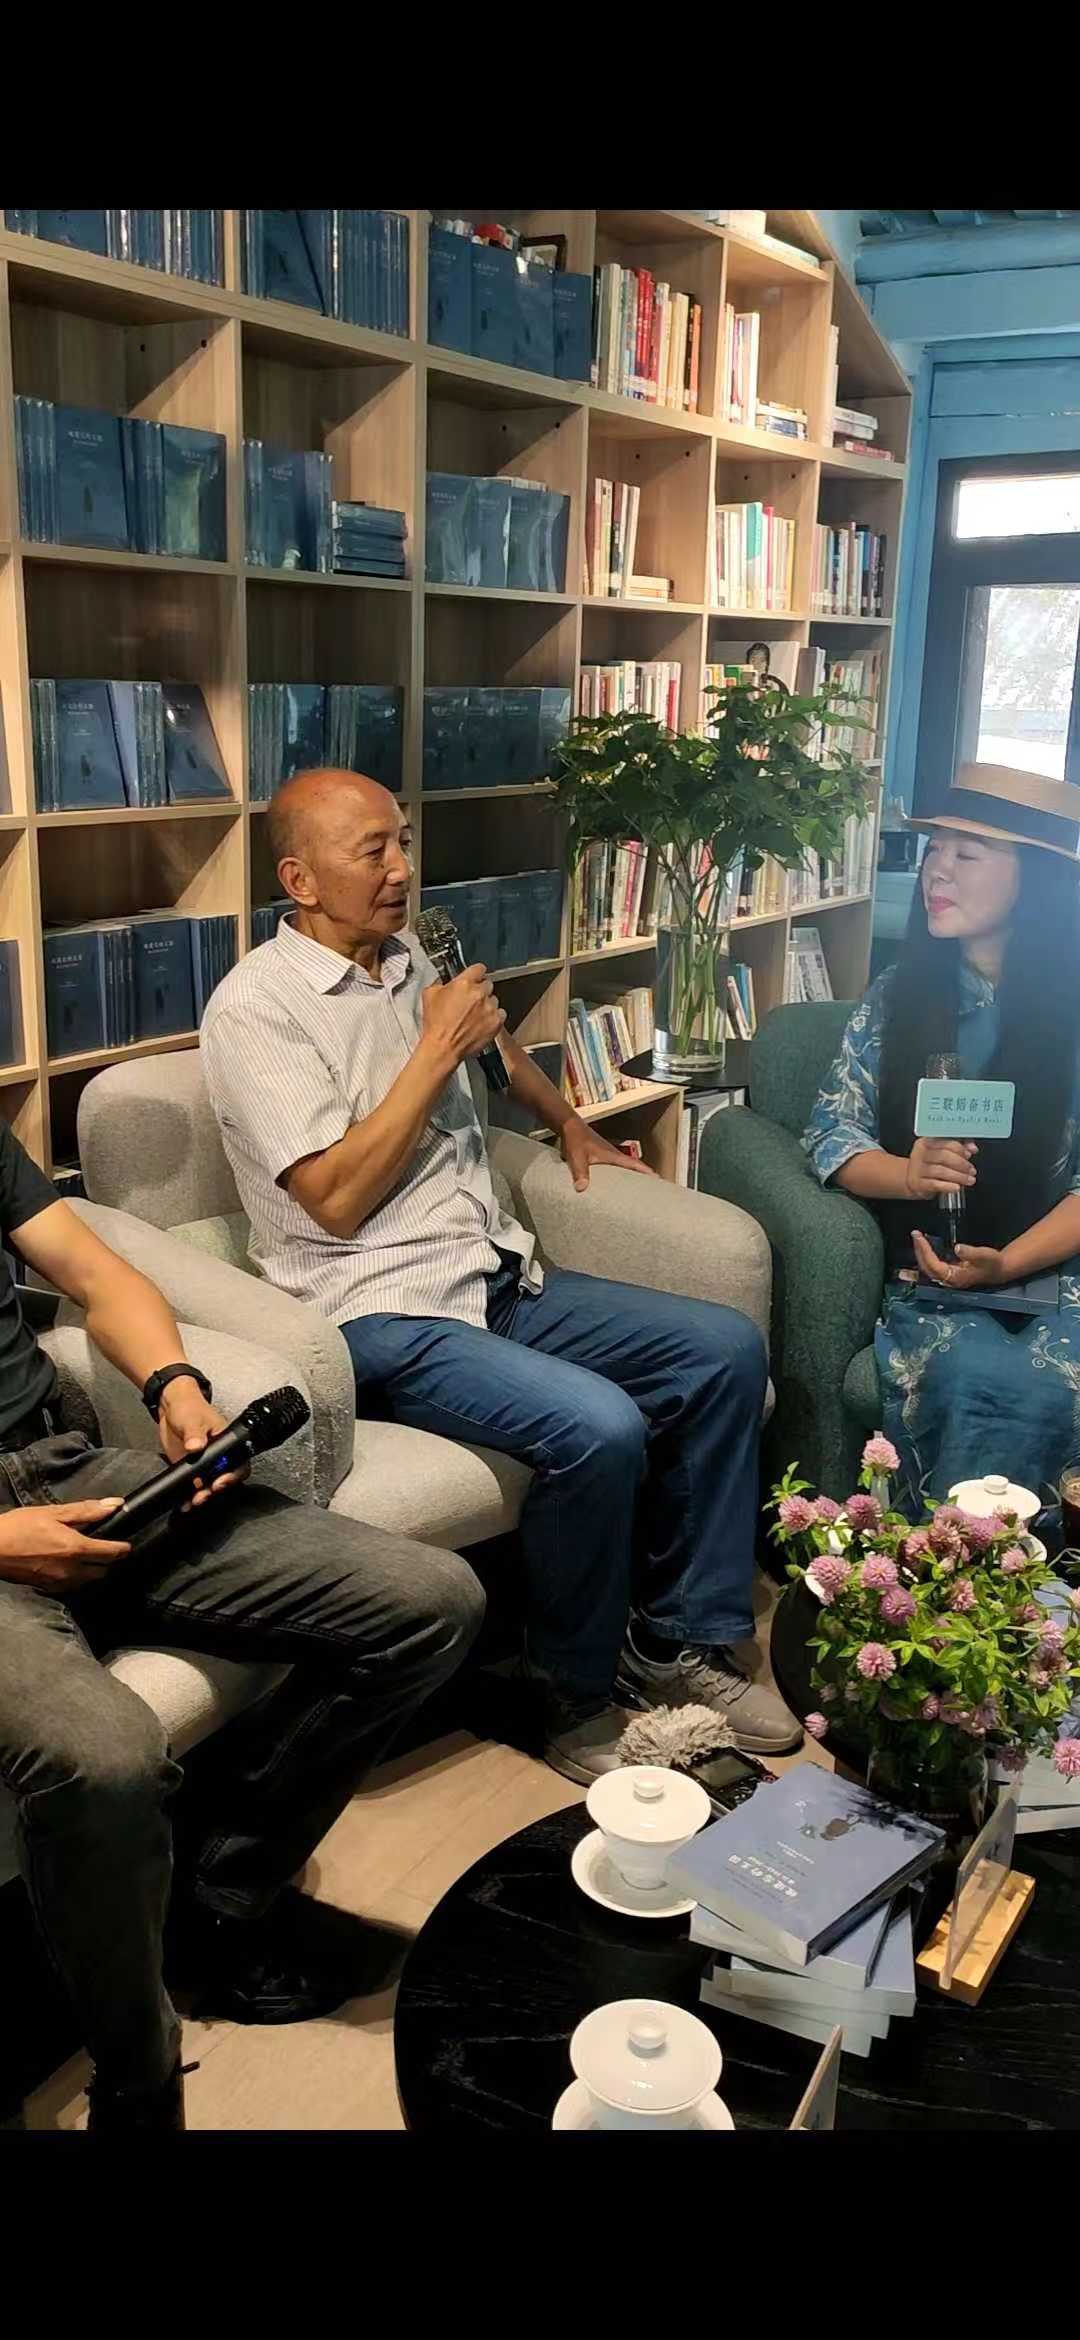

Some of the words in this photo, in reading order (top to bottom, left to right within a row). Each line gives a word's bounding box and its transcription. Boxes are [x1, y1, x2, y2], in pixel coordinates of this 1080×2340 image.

[929, 1096, 1004, 1113] 三联韬奋书店
